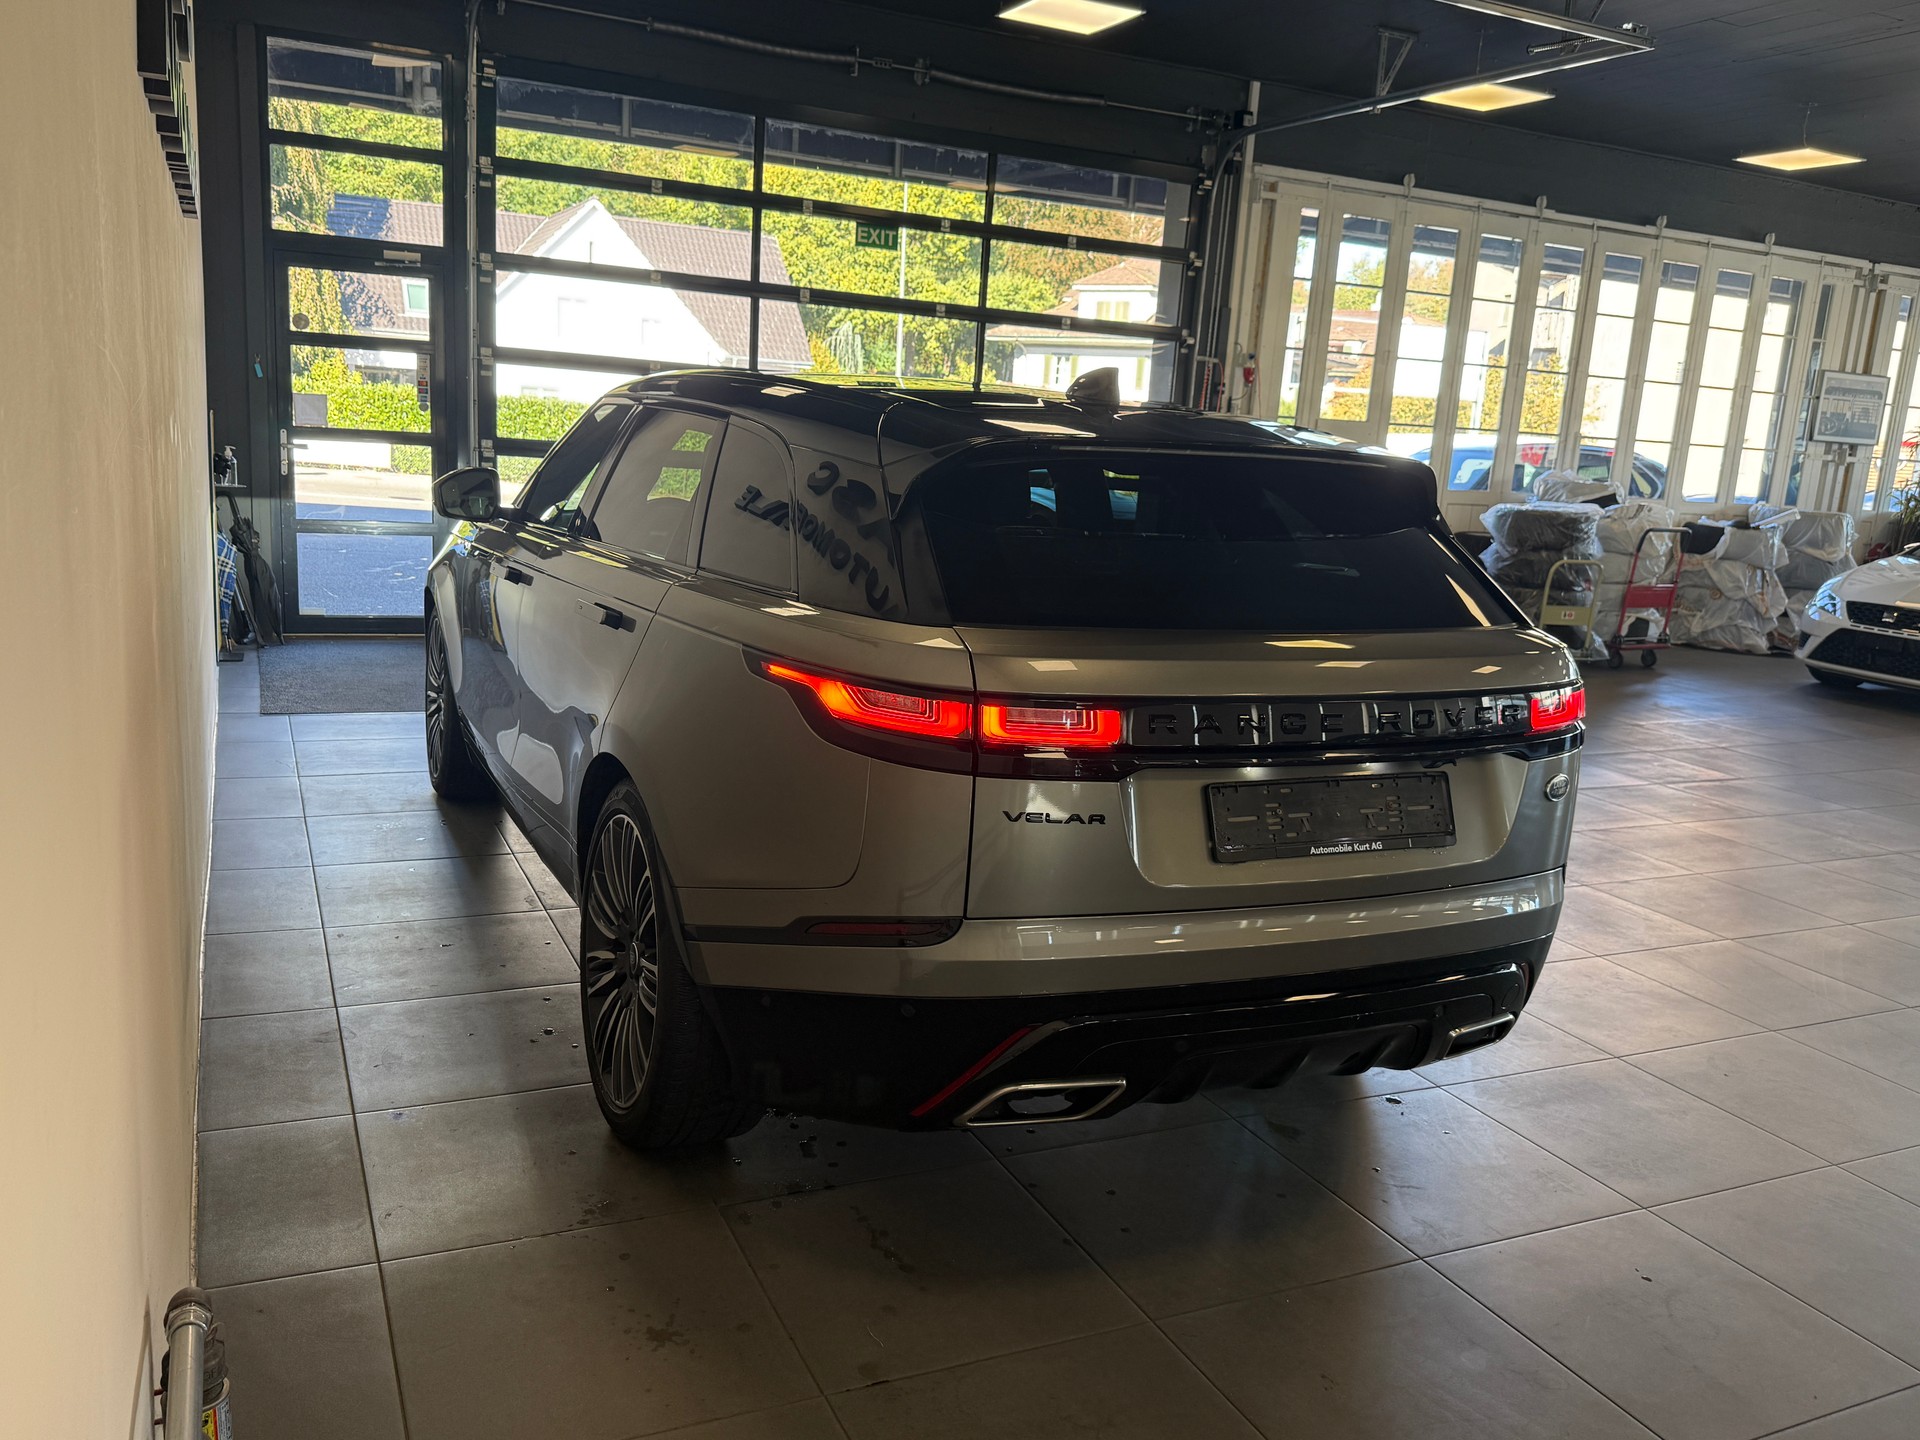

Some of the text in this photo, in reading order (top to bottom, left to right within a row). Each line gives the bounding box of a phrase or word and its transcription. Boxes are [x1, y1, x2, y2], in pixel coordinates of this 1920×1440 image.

[857, 226, 897, 247] EXIT
[1148, 705, 1521, 735] RANGE ROVER
[1002, 810, 1106, 825] VELAR
[1310, 841, 1383, 855] Automobile Kurt AG
